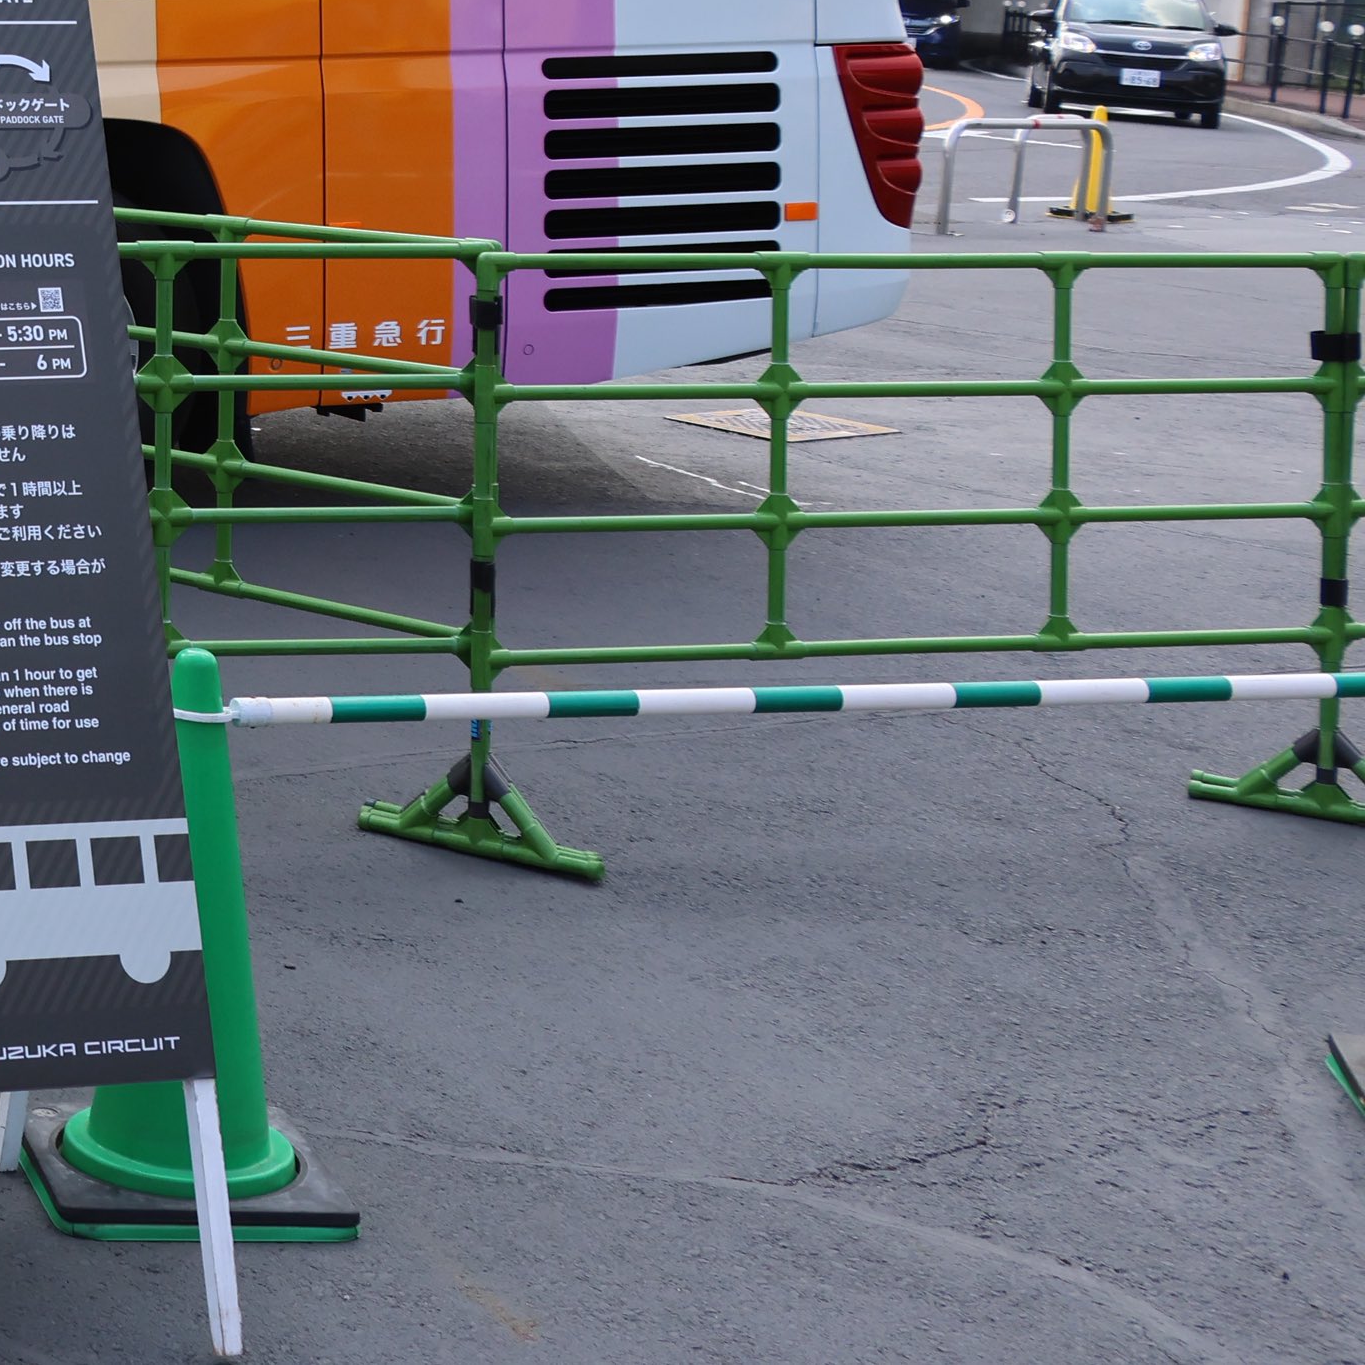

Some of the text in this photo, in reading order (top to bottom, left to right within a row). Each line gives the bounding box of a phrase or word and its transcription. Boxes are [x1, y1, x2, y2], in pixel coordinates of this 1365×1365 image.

[0, 115, 40, 124] PADDOCK
[42, 115, 65, 124] GATE
[21, 254, 74, 267] HOURS
[7, 325, 43, 341] 5:30
[49, 329, 67, 340] PM
[285, 319, 445, 349] 三重急行
[37, 355, 47, 370] 6
[52, 358, 71, 369] PM
[4, 618, 21, 630] off
[25, 618, 46, 630] the
[50, 617, 75, 629] bus
[79, 617, 91, 628] at
[19, 635, 40, 646] the
[44, 634, 69, 645] bus
[73, 633, 102, 646] stop
[13, 669, 19, 681] 1
[25, 669, 55, 680] hour
[59, 668, 72, 679] to
[76, 667, 97, 681] get
[4, 686, 39, 697] when
[43, 684, 77, 696] there
[81, 683, 93, 695] is
[39, 700, 69, 713] road
[3, 719, 16, 731] of
[20, 718, 48, 730] time
[52, 717, 71, 729] for
[75, 718, 99, 728] use
[12, 753, 61, 768] subject
[64, 753, 78, 764] to
[82, 751, 130, 764] change
[84, 1037, 180, 1054] CIRCUIT
